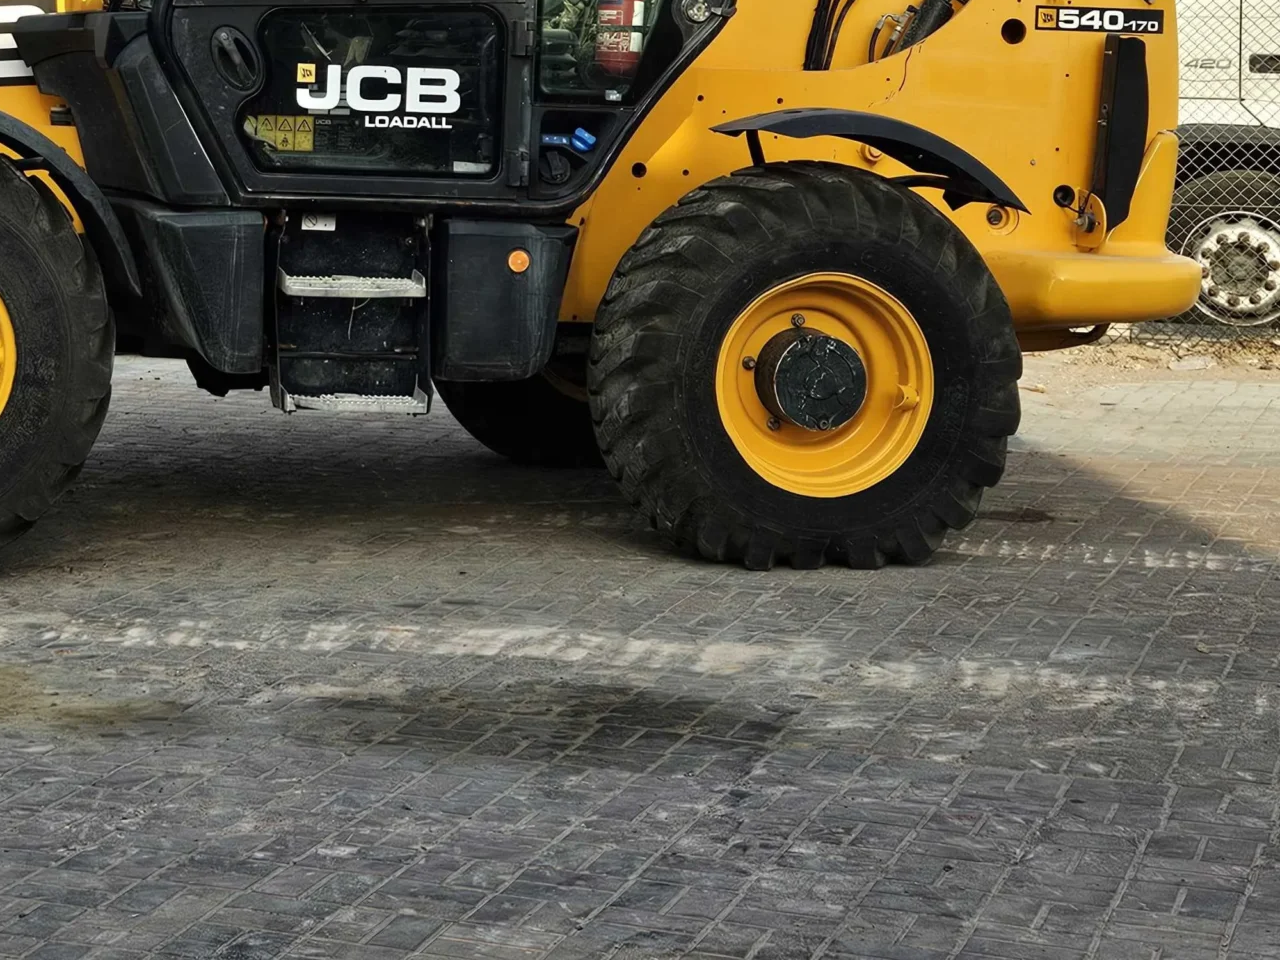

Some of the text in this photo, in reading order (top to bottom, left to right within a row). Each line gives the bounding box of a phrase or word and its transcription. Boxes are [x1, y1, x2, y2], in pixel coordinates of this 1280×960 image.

[1184, 58, 1233, 69] 420
[296, 64, 461, 114] JCB
[364, 115, 452, 129] LOADALL
